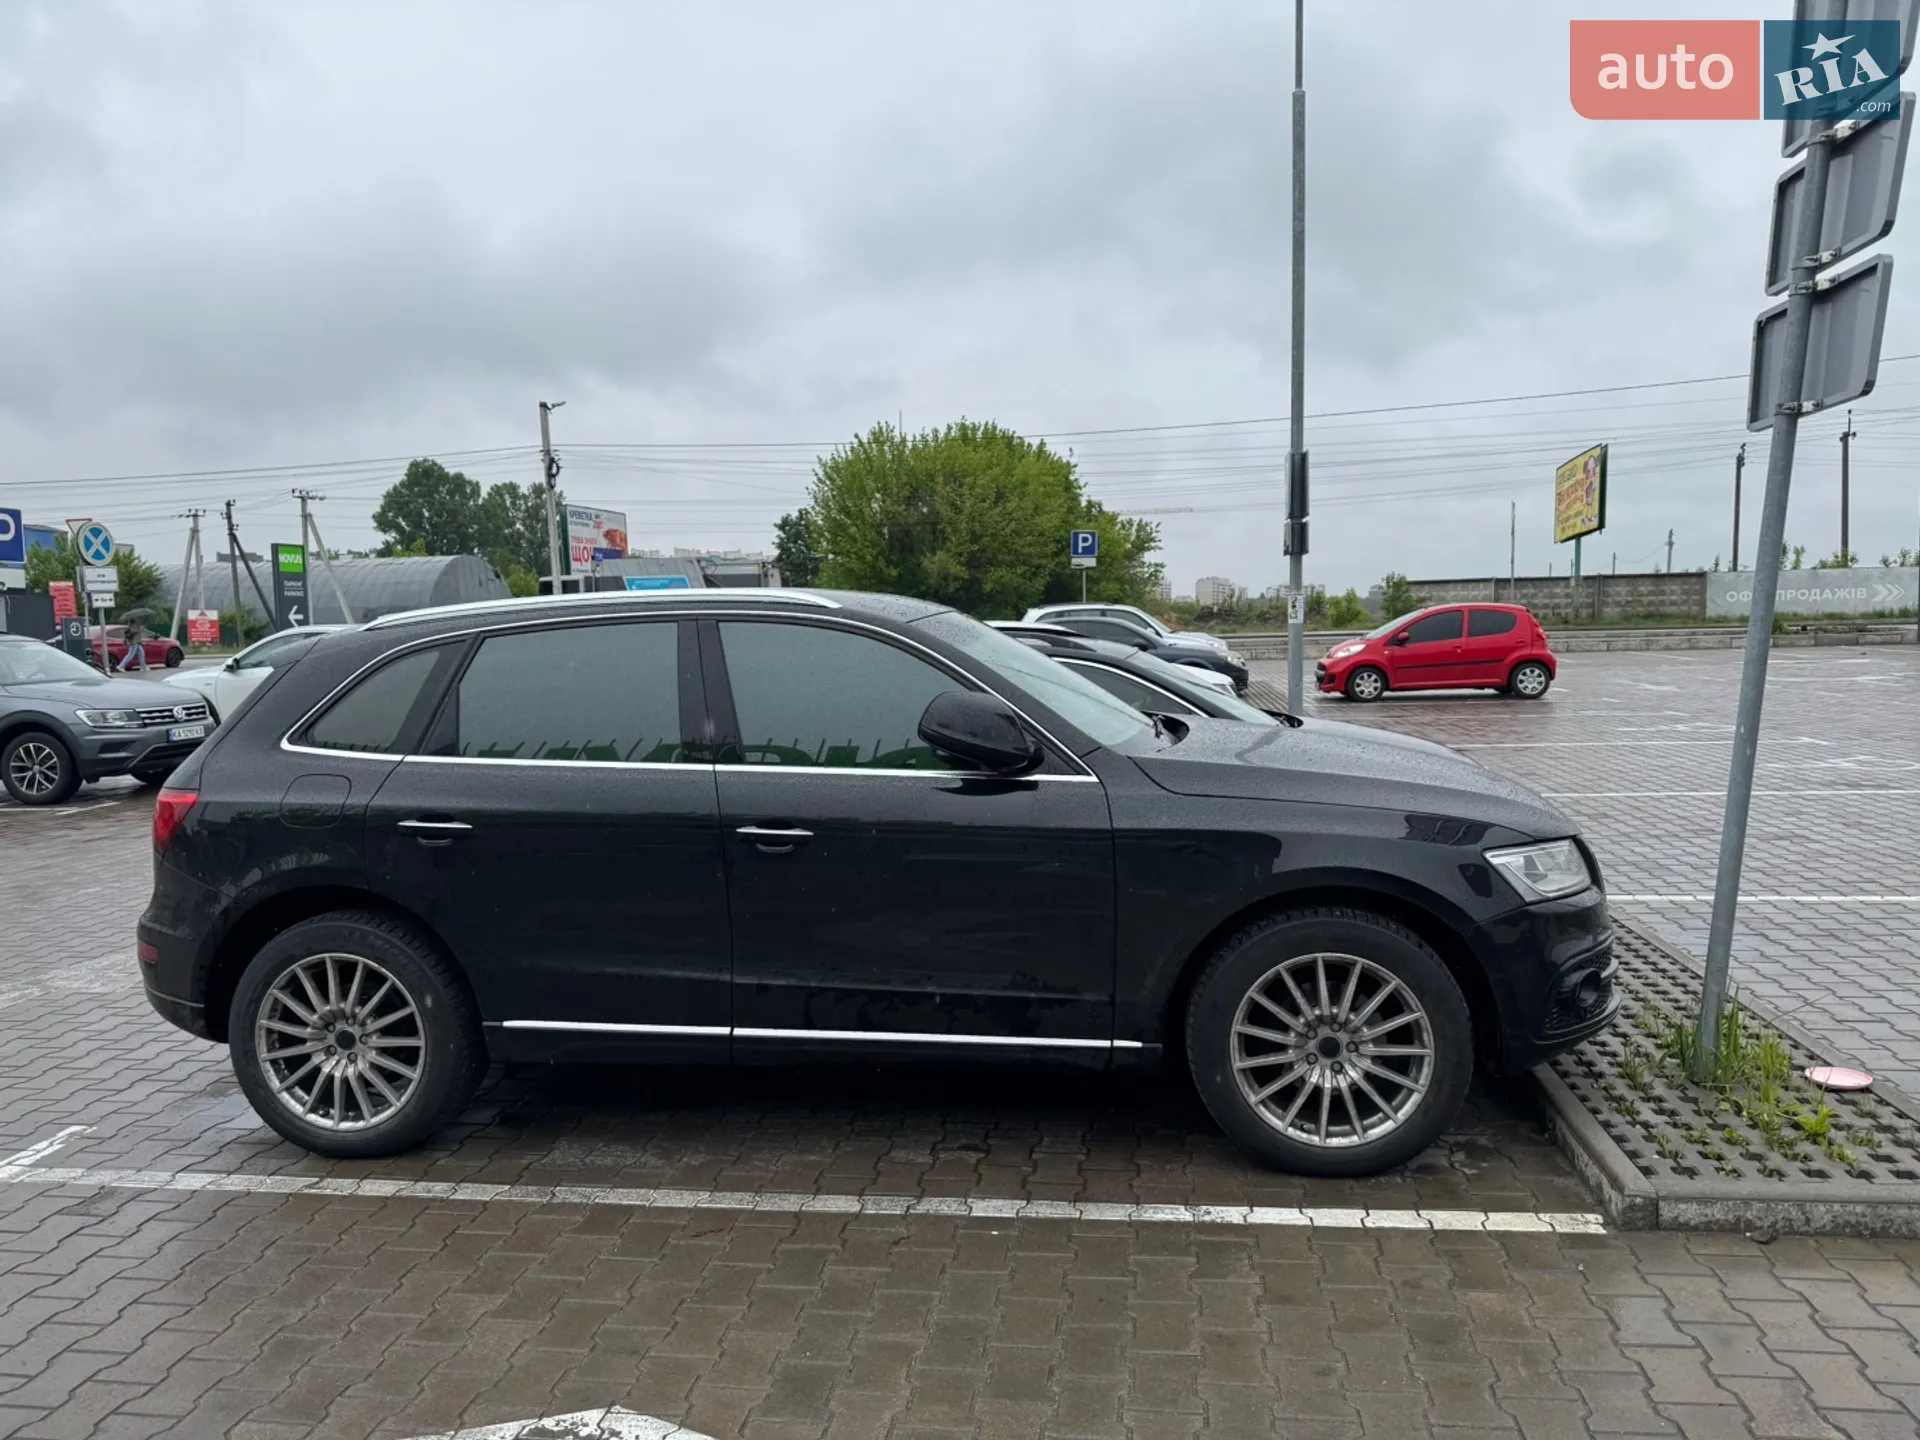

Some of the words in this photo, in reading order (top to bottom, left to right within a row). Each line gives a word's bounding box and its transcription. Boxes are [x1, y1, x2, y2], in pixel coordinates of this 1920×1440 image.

[1078, 533, 1093, 554] P
[279, 553, 303, 564] NOVUS
[1725, 590, 1753, 602] ОФ
[1775, 587, 1867, 602] ПРОДАЖІВ
